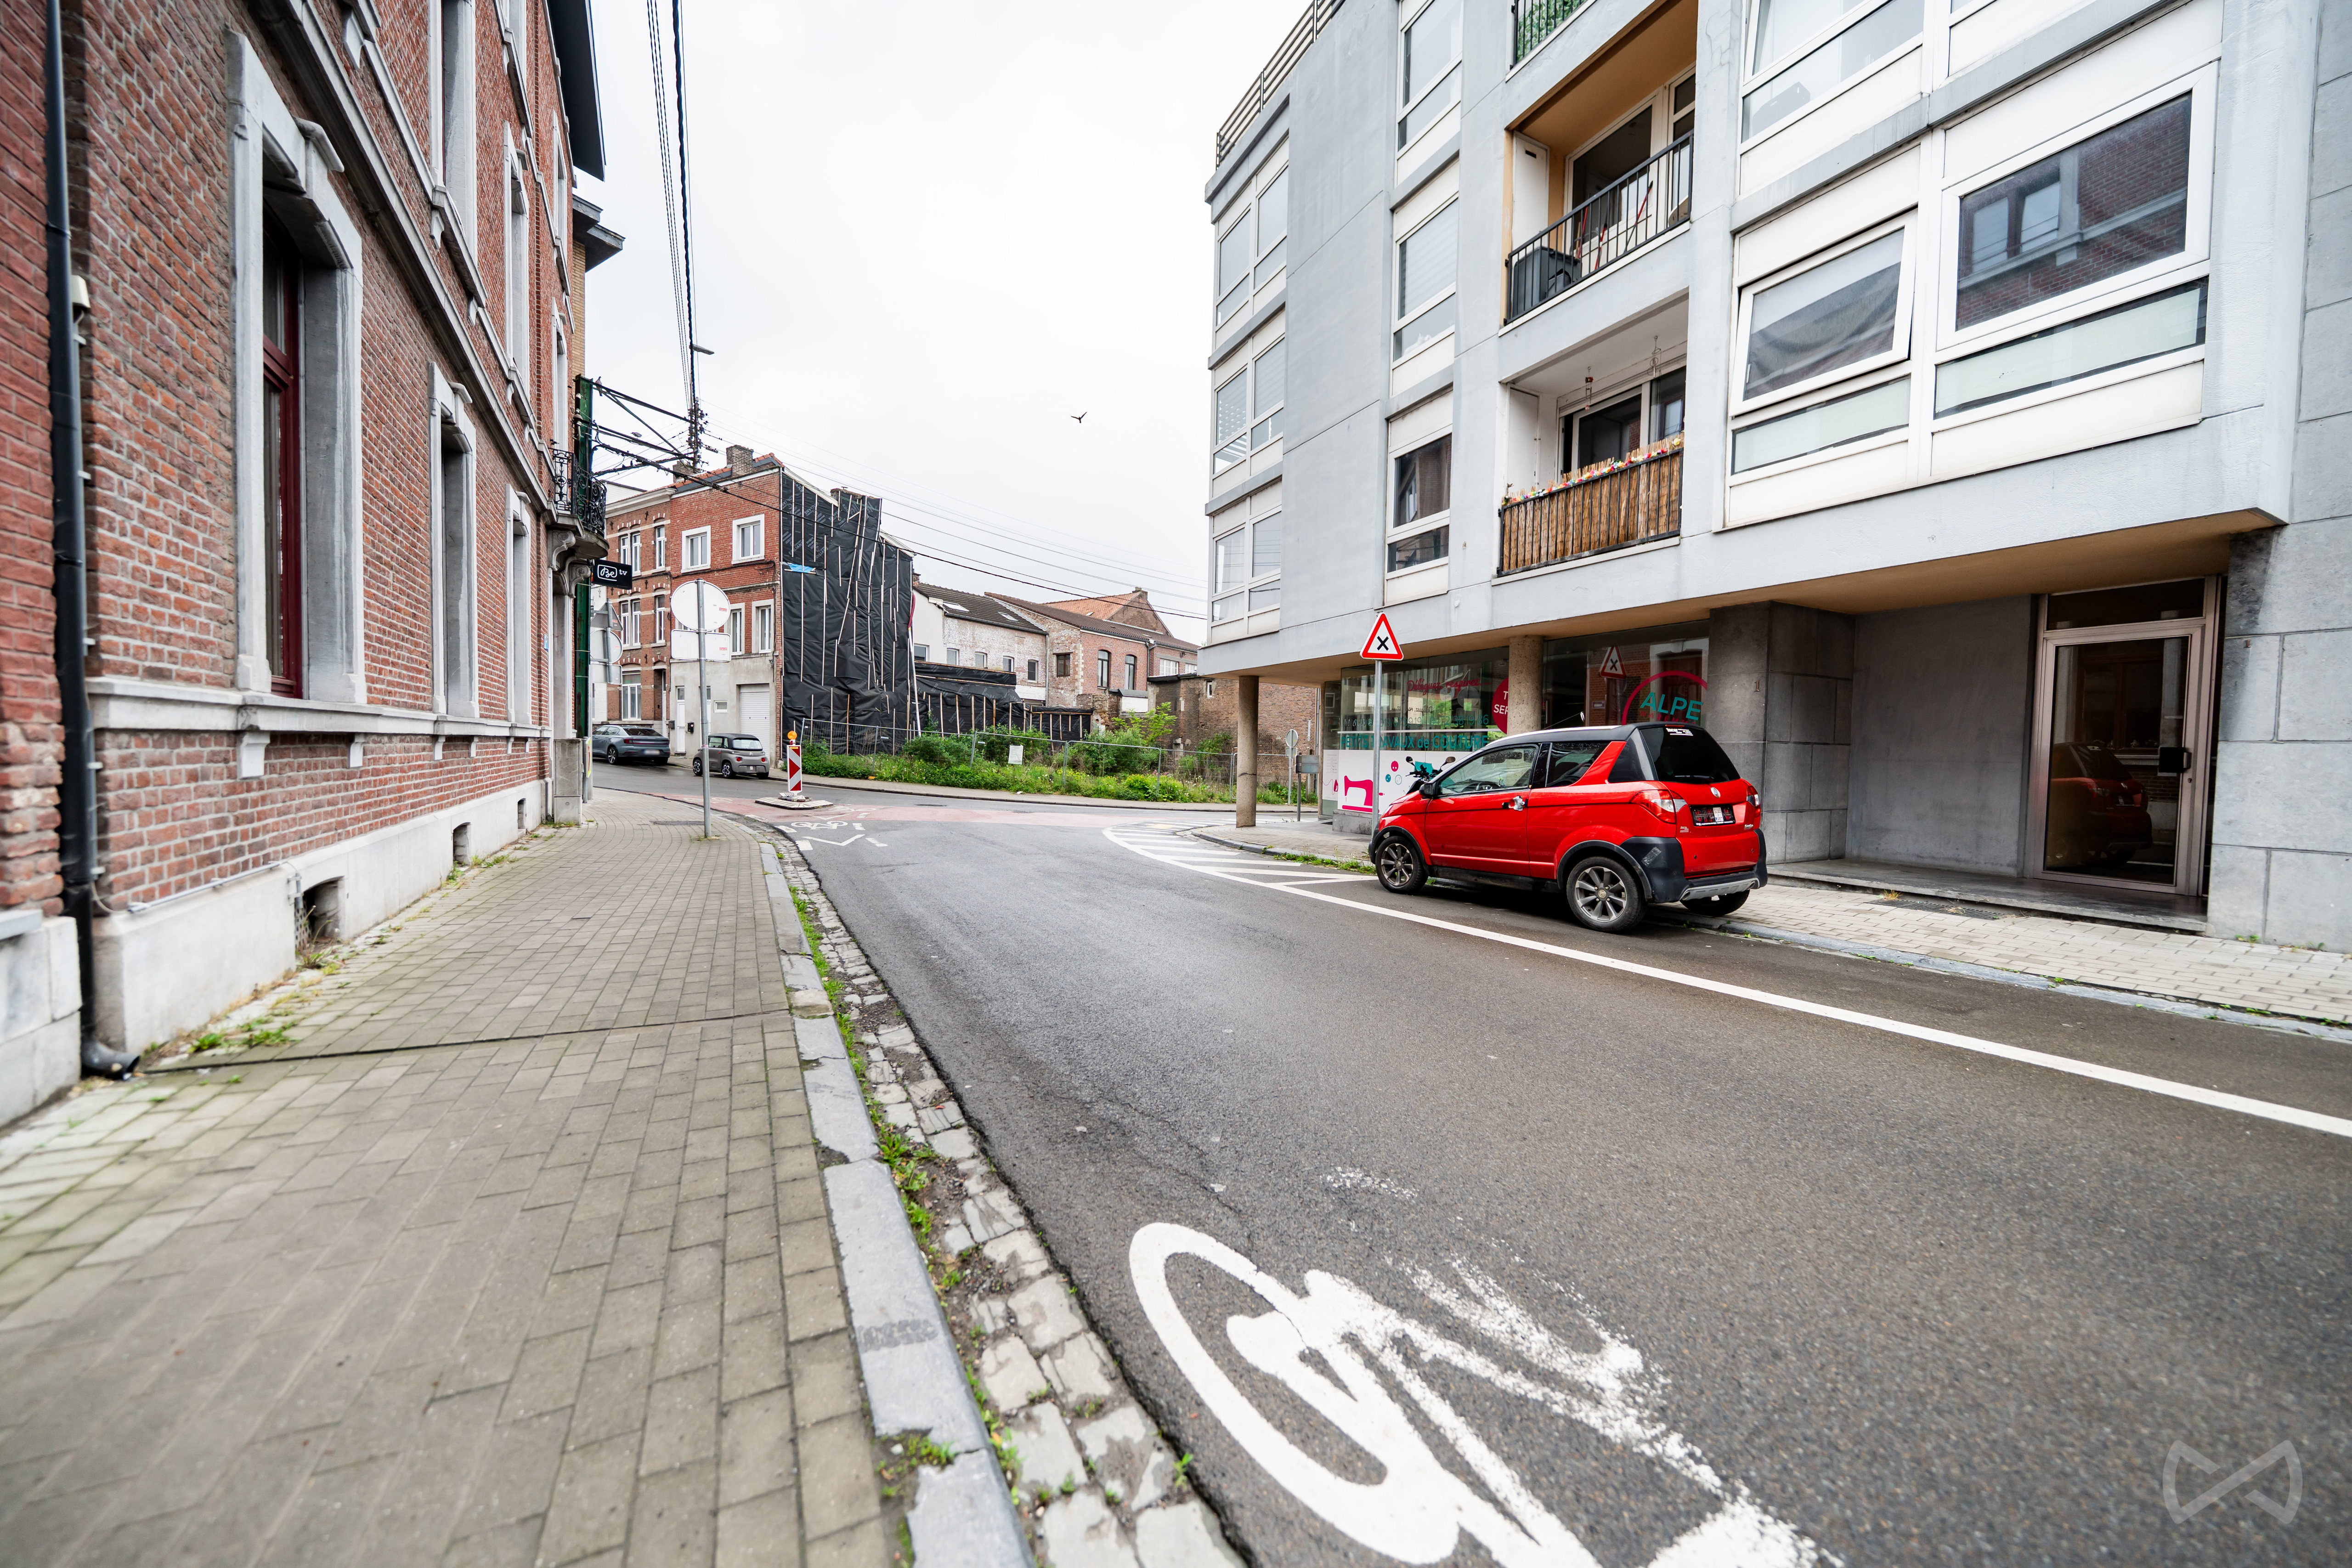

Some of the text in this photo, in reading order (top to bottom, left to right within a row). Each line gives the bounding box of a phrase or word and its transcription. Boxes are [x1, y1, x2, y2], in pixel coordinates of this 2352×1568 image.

[600, 567, 617, 577] Be
[1754, 680, 1760, 691] 1
[1640, 692, 1703, 720] ALPE
[1640, 710, 1696, 724] WAREMM
[1341, 735, 1368, 748] PETITS
[1418, 736, 1430, 748] de
[1433, 735, 1489, 749] COUTURE
